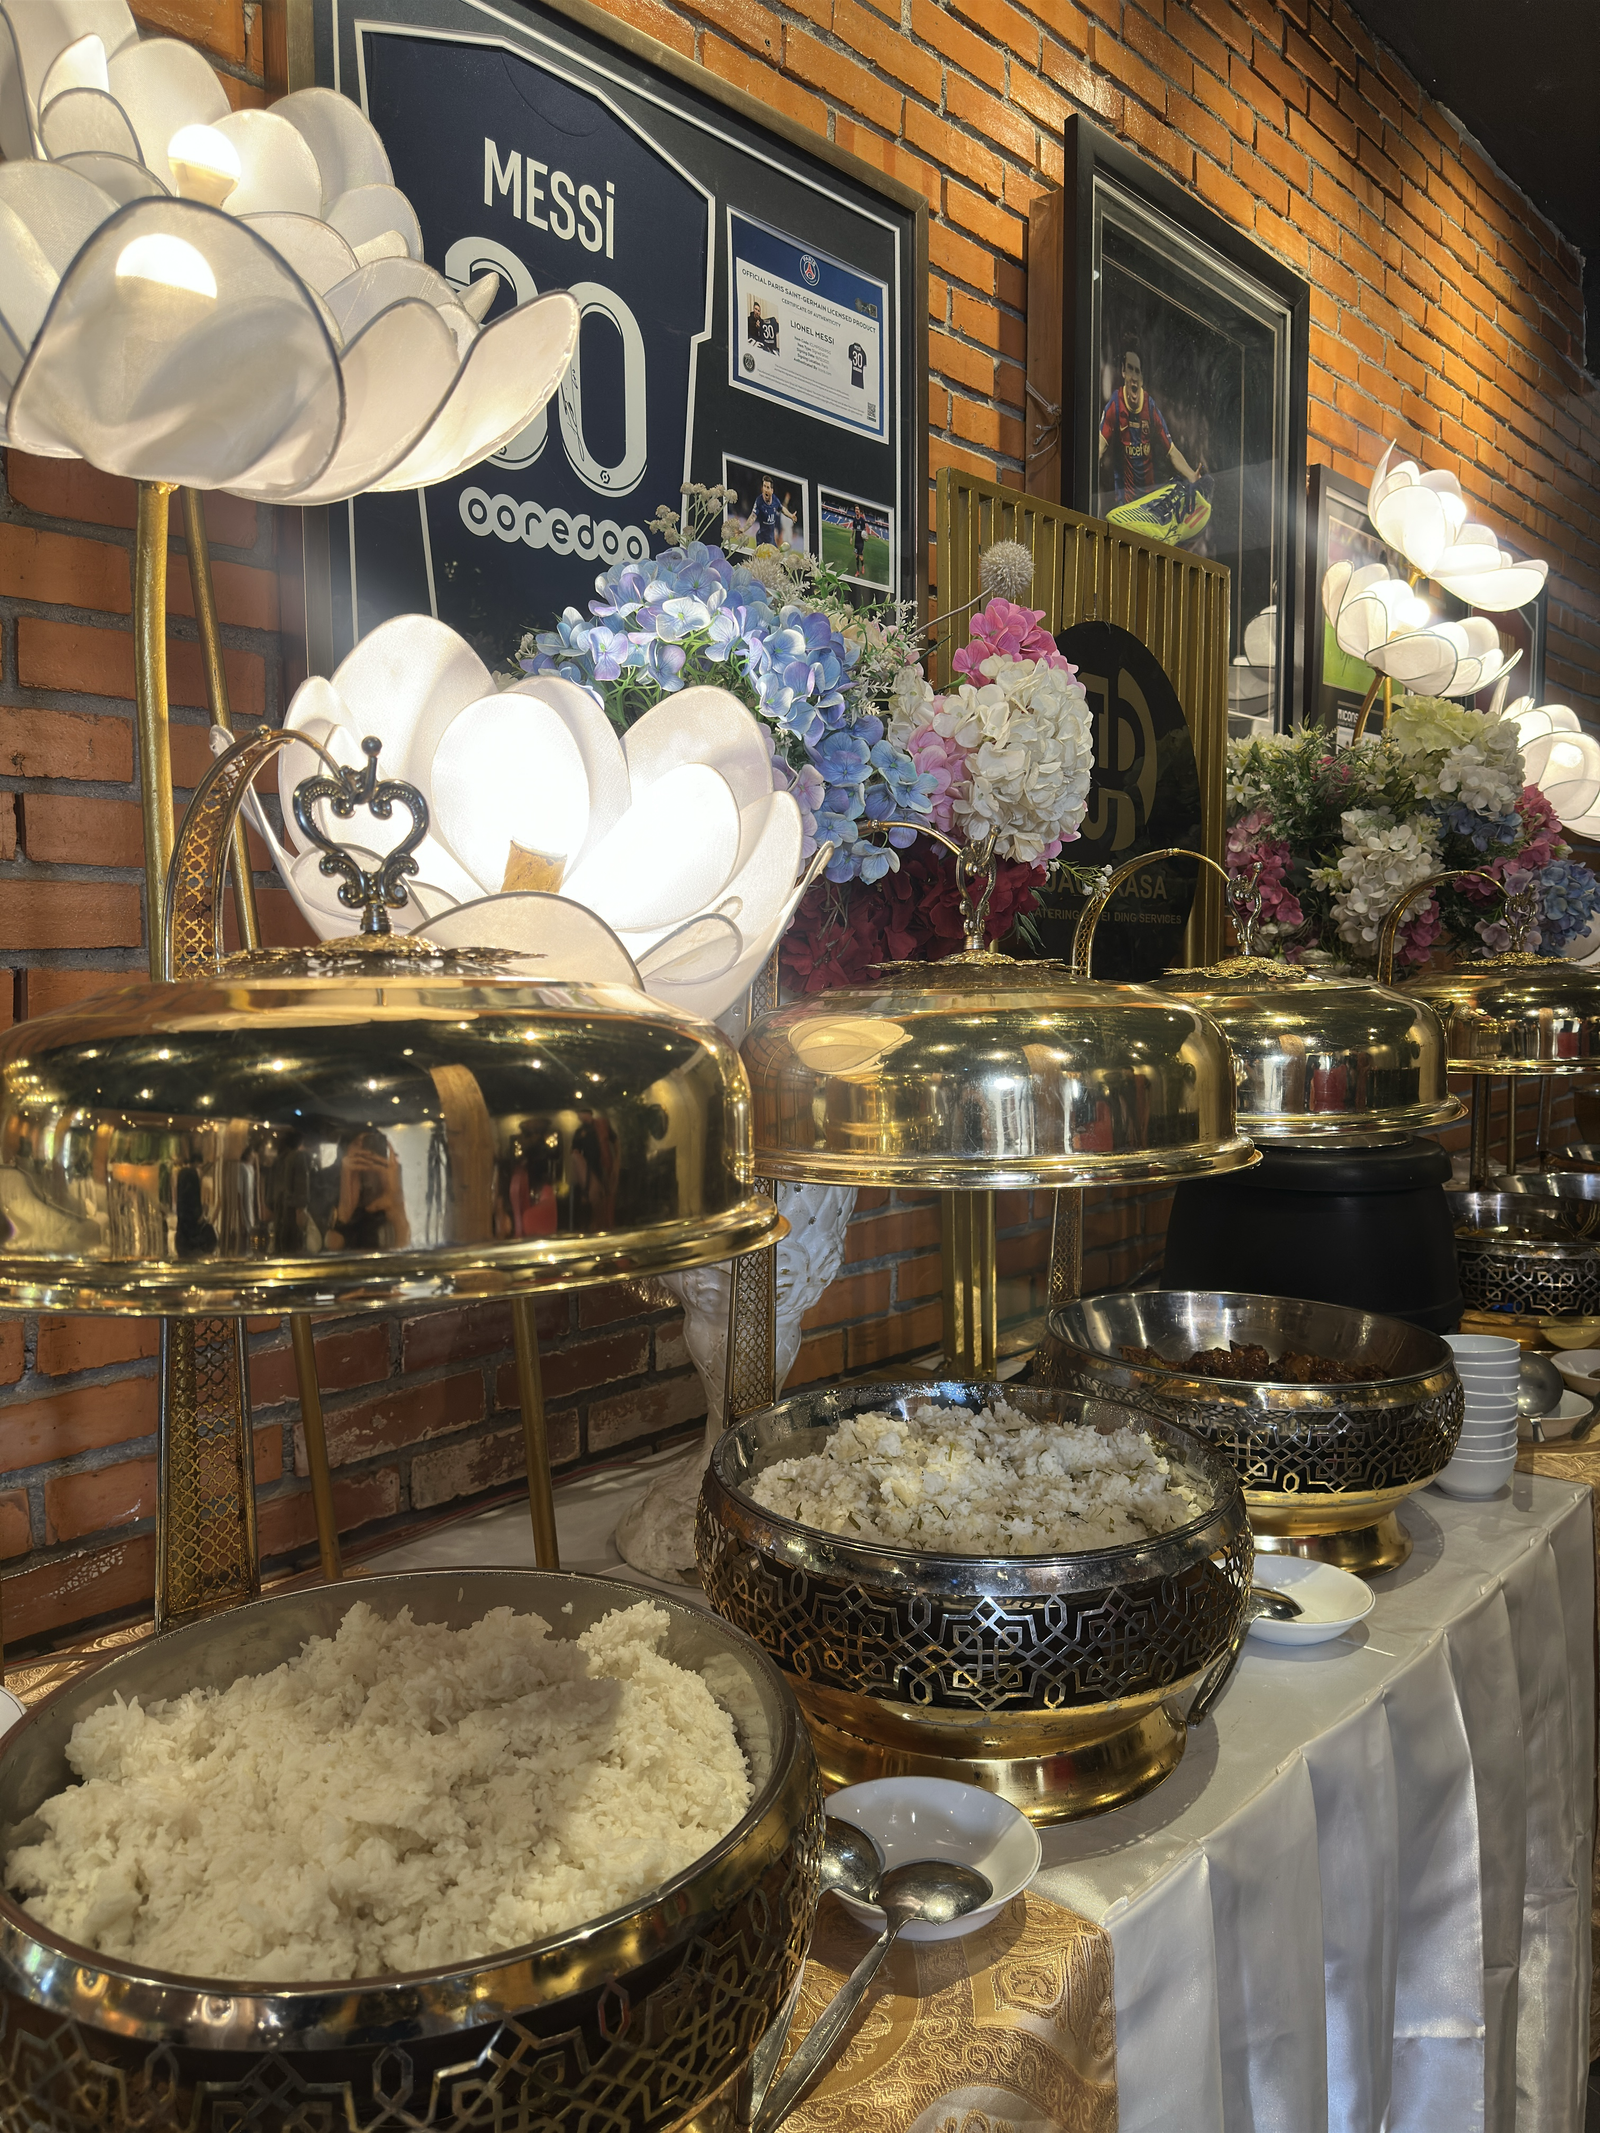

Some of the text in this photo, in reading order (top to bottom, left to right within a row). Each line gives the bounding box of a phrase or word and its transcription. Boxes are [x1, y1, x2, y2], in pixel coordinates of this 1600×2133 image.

[742, 268, 767, 285] OFFICIAL
[768, 280, 784, 293] PARIS
[785, 287, 827, 312] SAINT-GERMAIN
[827, 306, 852, 323] LICENSED
[853, 318, 876, 334] PRODUCT
[782, 297, 806, 313] CERTIFICATE
[813, 311, 841, 328] AUTHENTICITY
[791, 320, 835, 346] LIONEL MESSI
[852, 350, 863, 369] 30
[463, 491, 646, 562] ooredoo
[1030, 908, 1079, 921] ATERING
[1138, 912, 1182, 925] SERVICES
